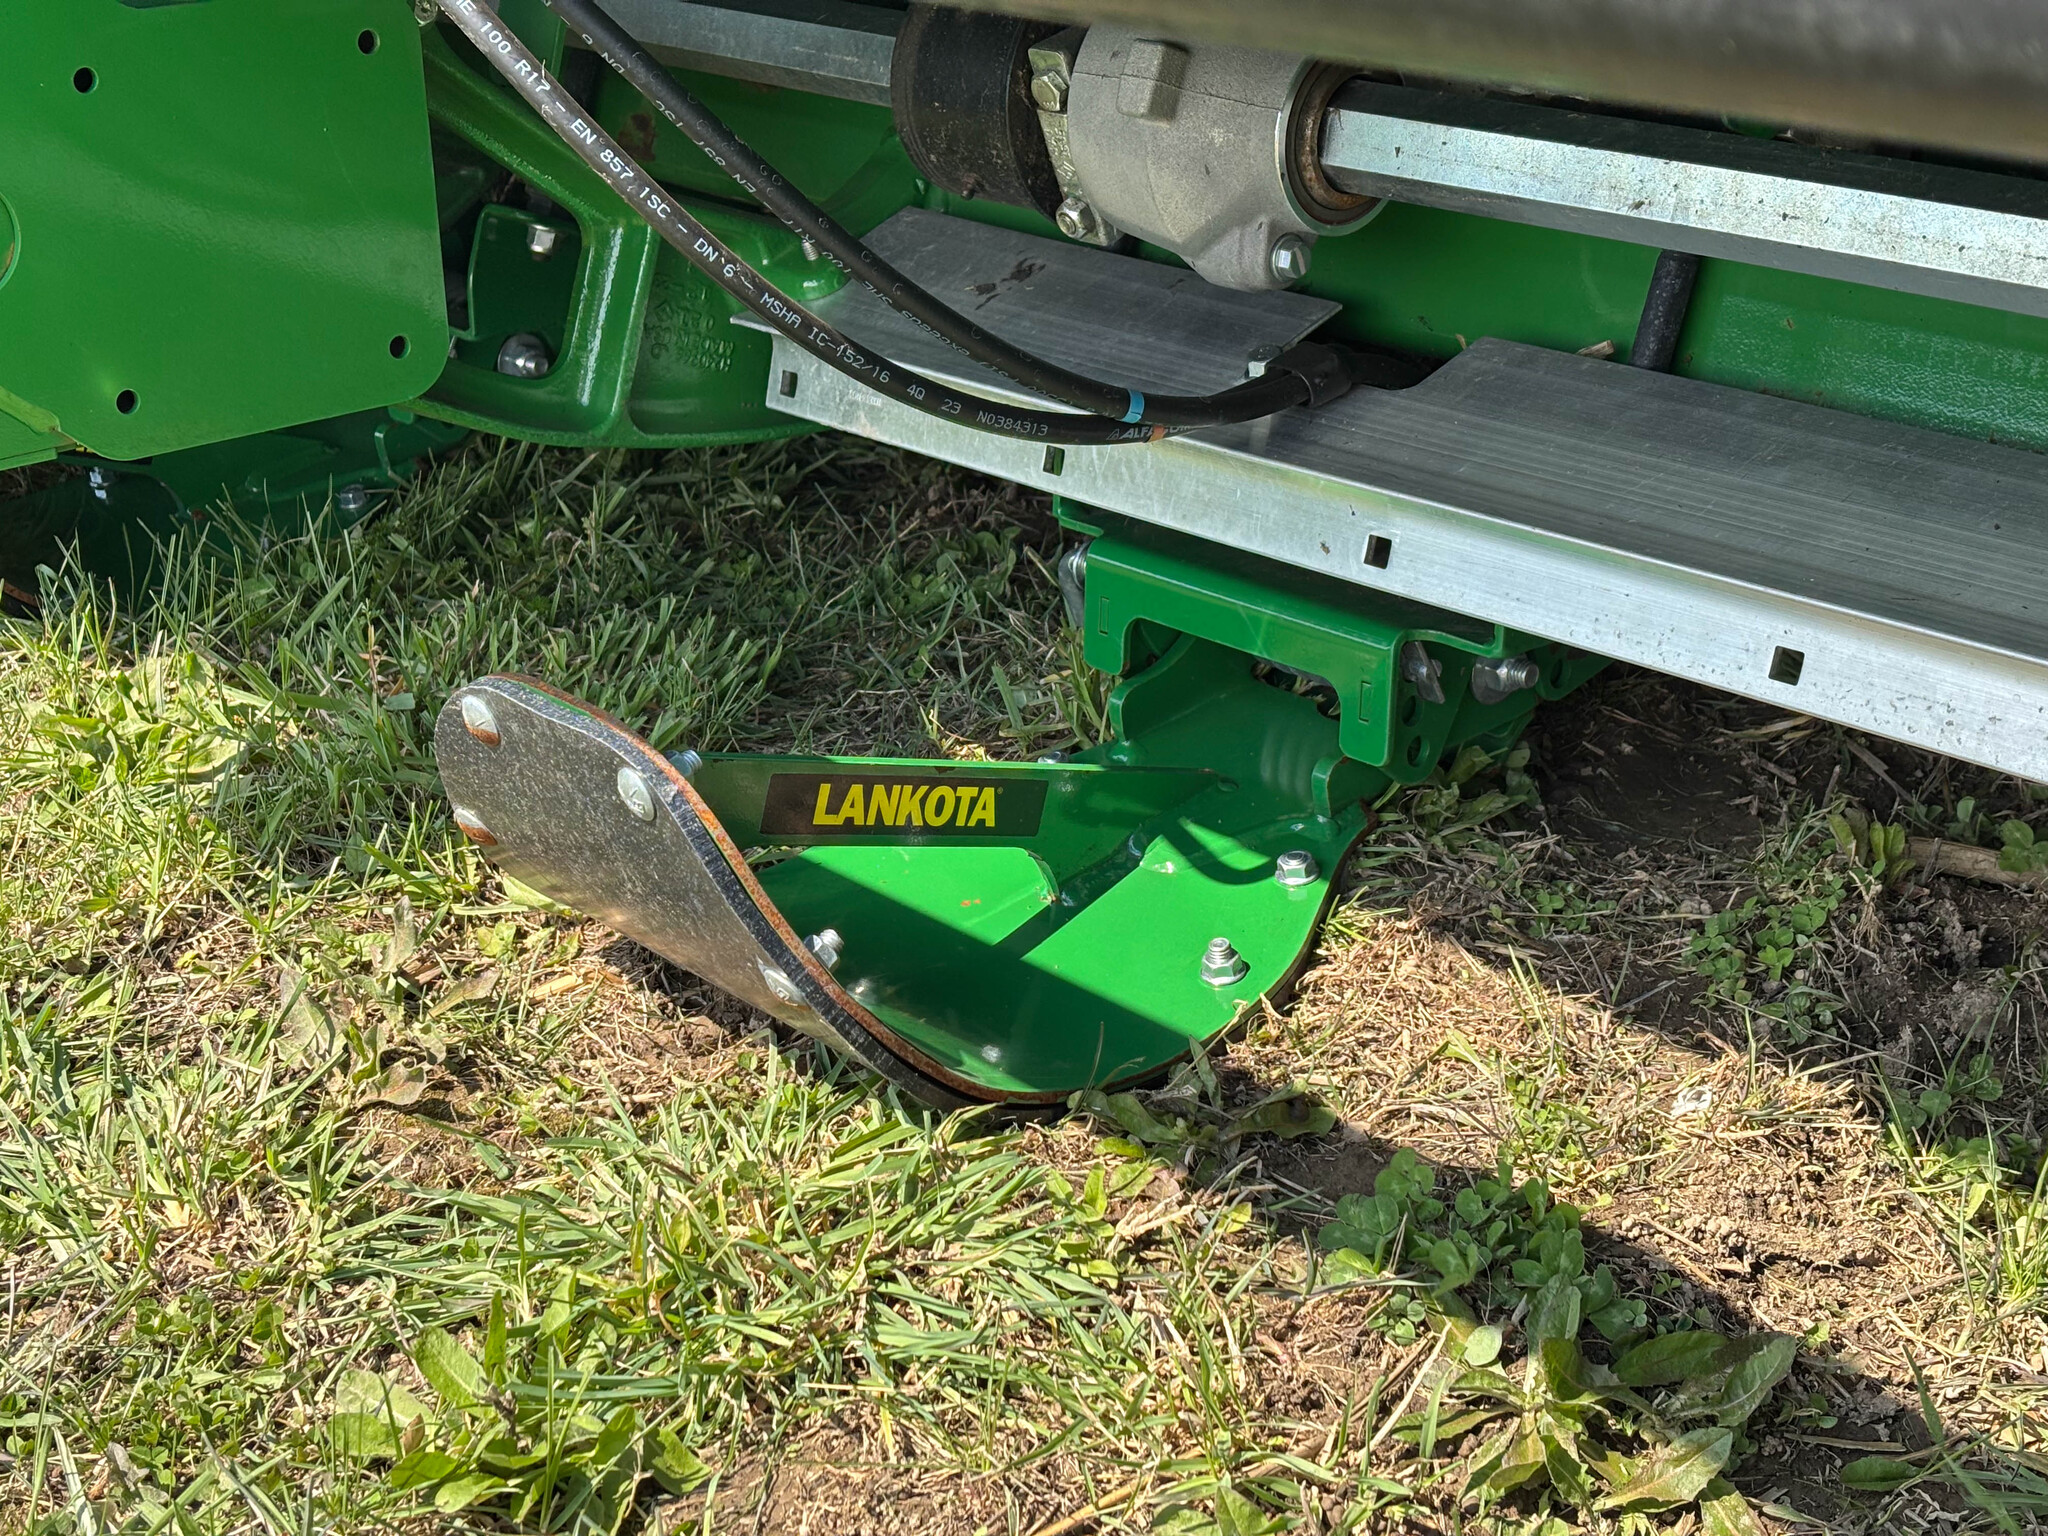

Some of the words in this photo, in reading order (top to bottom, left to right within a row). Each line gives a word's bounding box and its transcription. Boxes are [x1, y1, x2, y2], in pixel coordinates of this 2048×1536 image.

[480, 21, 512, 54] 100
[514, 59, 551, 93] R17
[571, 118, 598, 145] EN
[600, 148, 634, 179] 857
[640, 186, 671, 218] 1SC
[693, 237, 719, 262] DN
[722, 263, 736, 277] 6
[760, 292, 802, 328] MSHA
[807, 326, 891, 383] IC-152/16
[906, 384, 926, 401] 4Q
[941, 398, 962, 414] 23
[812, 783, 996, 827] LANKOTA
